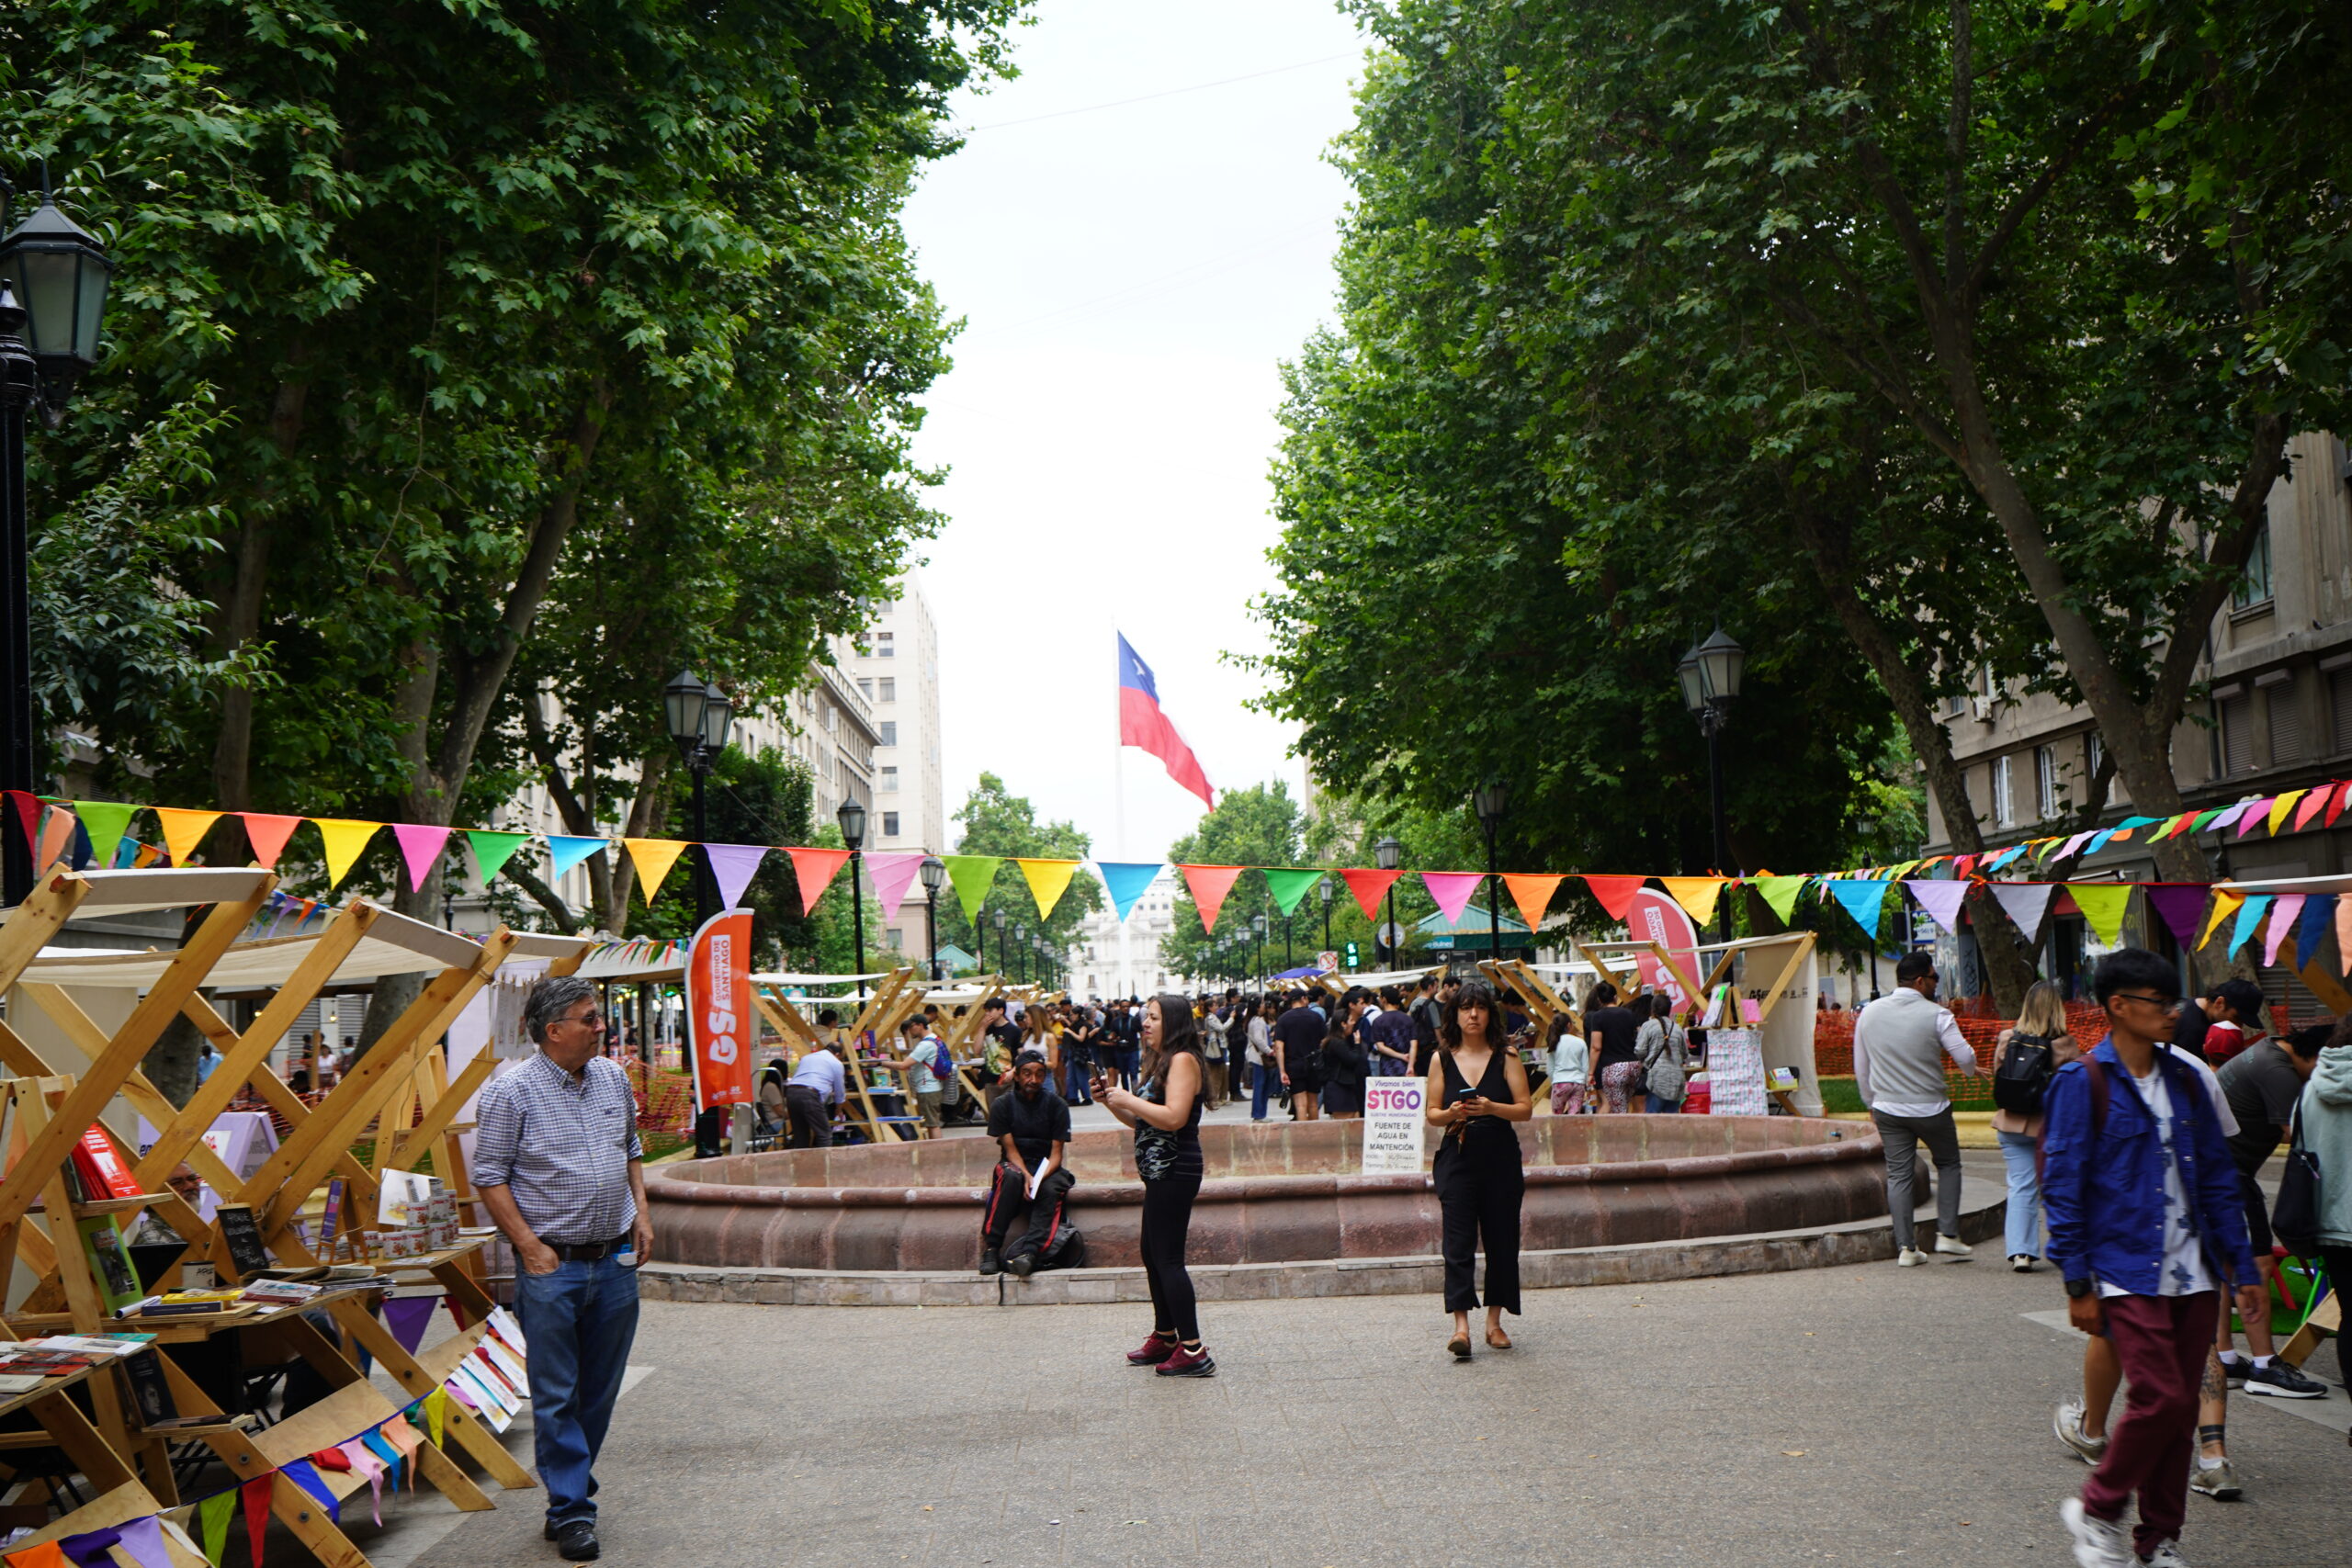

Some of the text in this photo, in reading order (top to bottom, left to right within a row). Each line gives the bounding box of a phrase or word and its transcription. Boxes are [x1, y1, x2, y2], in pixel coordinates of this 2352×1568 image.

[713, 941, 720, 953] DE
[721, 940, 730, 1000] SANTIAGO
[709, 1010, 738, 1066] GS
[1367, 1089, 1420, 1110] STGO
[1374, 1122, 1412, 1130] FUENTE DE
[1398, 1132, 1408, 1140] EN
[1369, 1143, 1415, 1151] MANTENCIÓN
